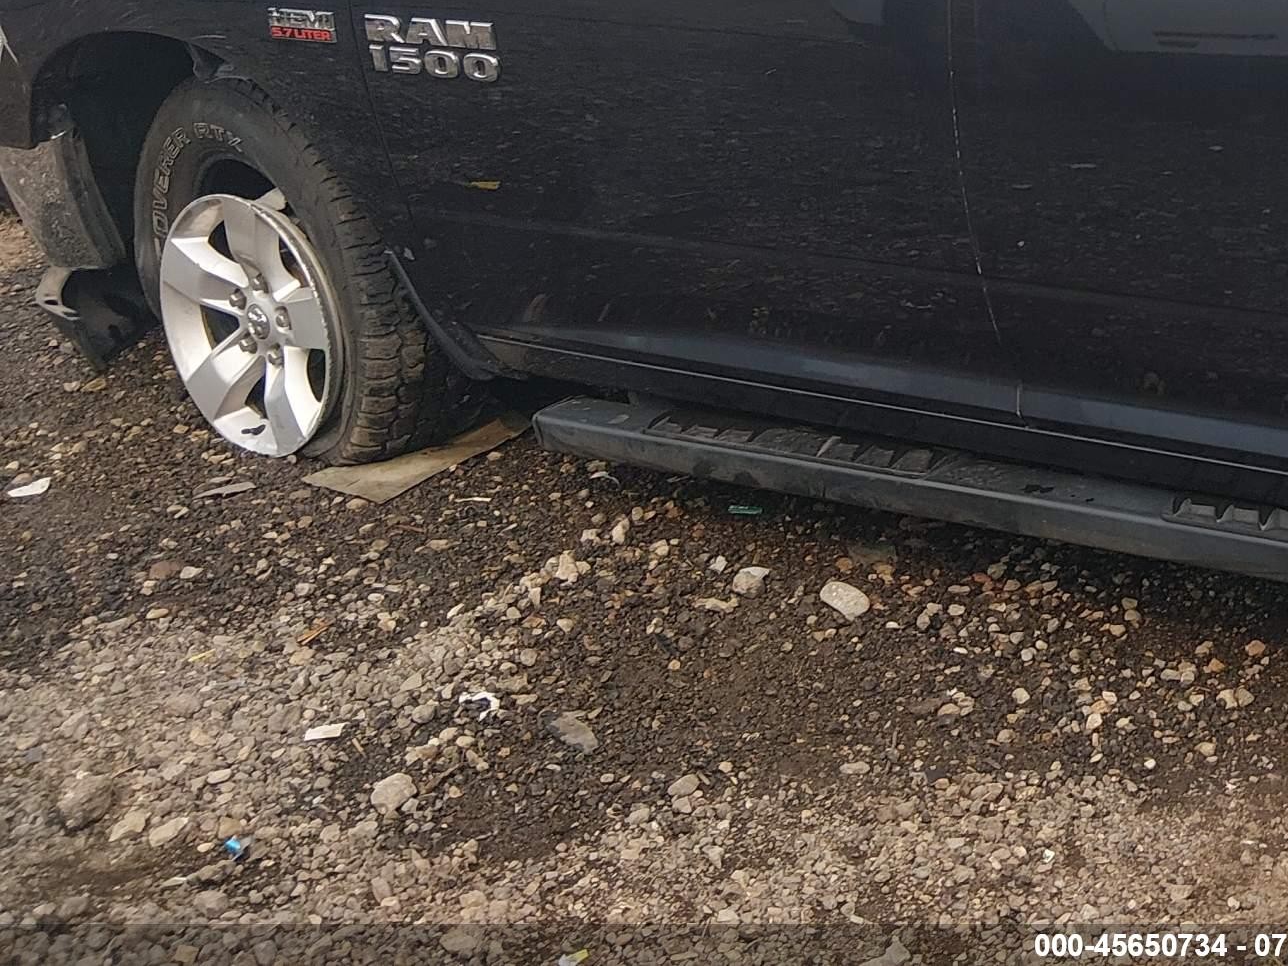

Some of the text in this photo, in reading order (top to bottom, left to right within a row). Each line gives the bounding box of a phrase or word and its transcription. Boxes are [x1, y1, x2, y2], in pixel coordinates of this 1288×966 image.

[267, 7, 336, 31] HEMI
[294, 28, 331, 41] LITER
[364, 13, 498, 51] RAM
[368, 44, 502, 83] 1500
